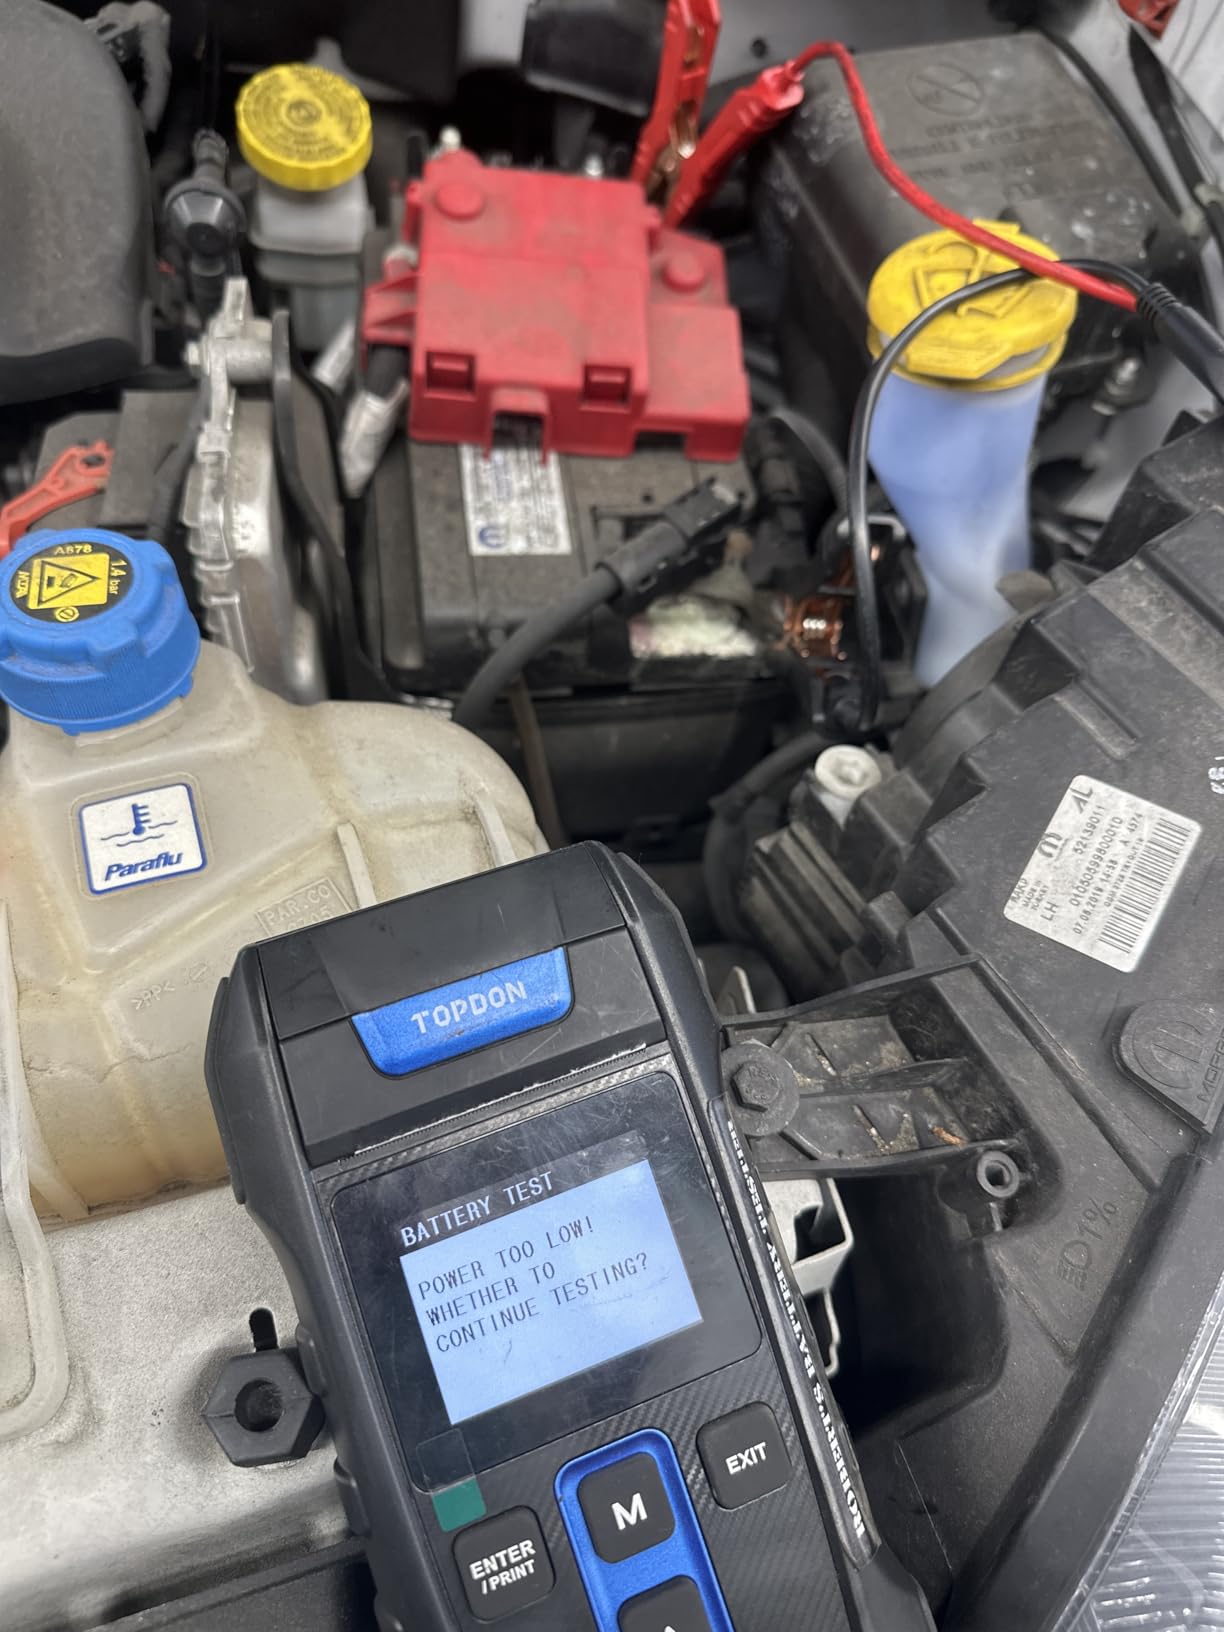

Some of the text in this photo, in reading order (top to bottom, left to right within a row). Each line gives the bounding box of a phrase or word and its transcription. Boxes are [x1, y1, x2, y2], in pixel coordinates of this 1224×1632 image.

[109, 579, 121, 595] bar
[105, 851, 183, 882] Paraflu
[1040, 901, 1057, 921] LH
[410, 980, 528, 1034] TOPDON
[400, 1170, 555, 1248] BATTERY TEST
[418, 1215, 594, 1300] POWER TOO LOW!
[425, 1261, 556, 1327] WHETHER TO
[435, 1251, 648, 1353] CONTINUE TESTING?
[725, 1441, 767, 1475] EXIT
[611, 1492, 648, 1531] M
[469, 1539, 536, 1580] ENTER
[481, 1559, 536, 1594] /PRINT
